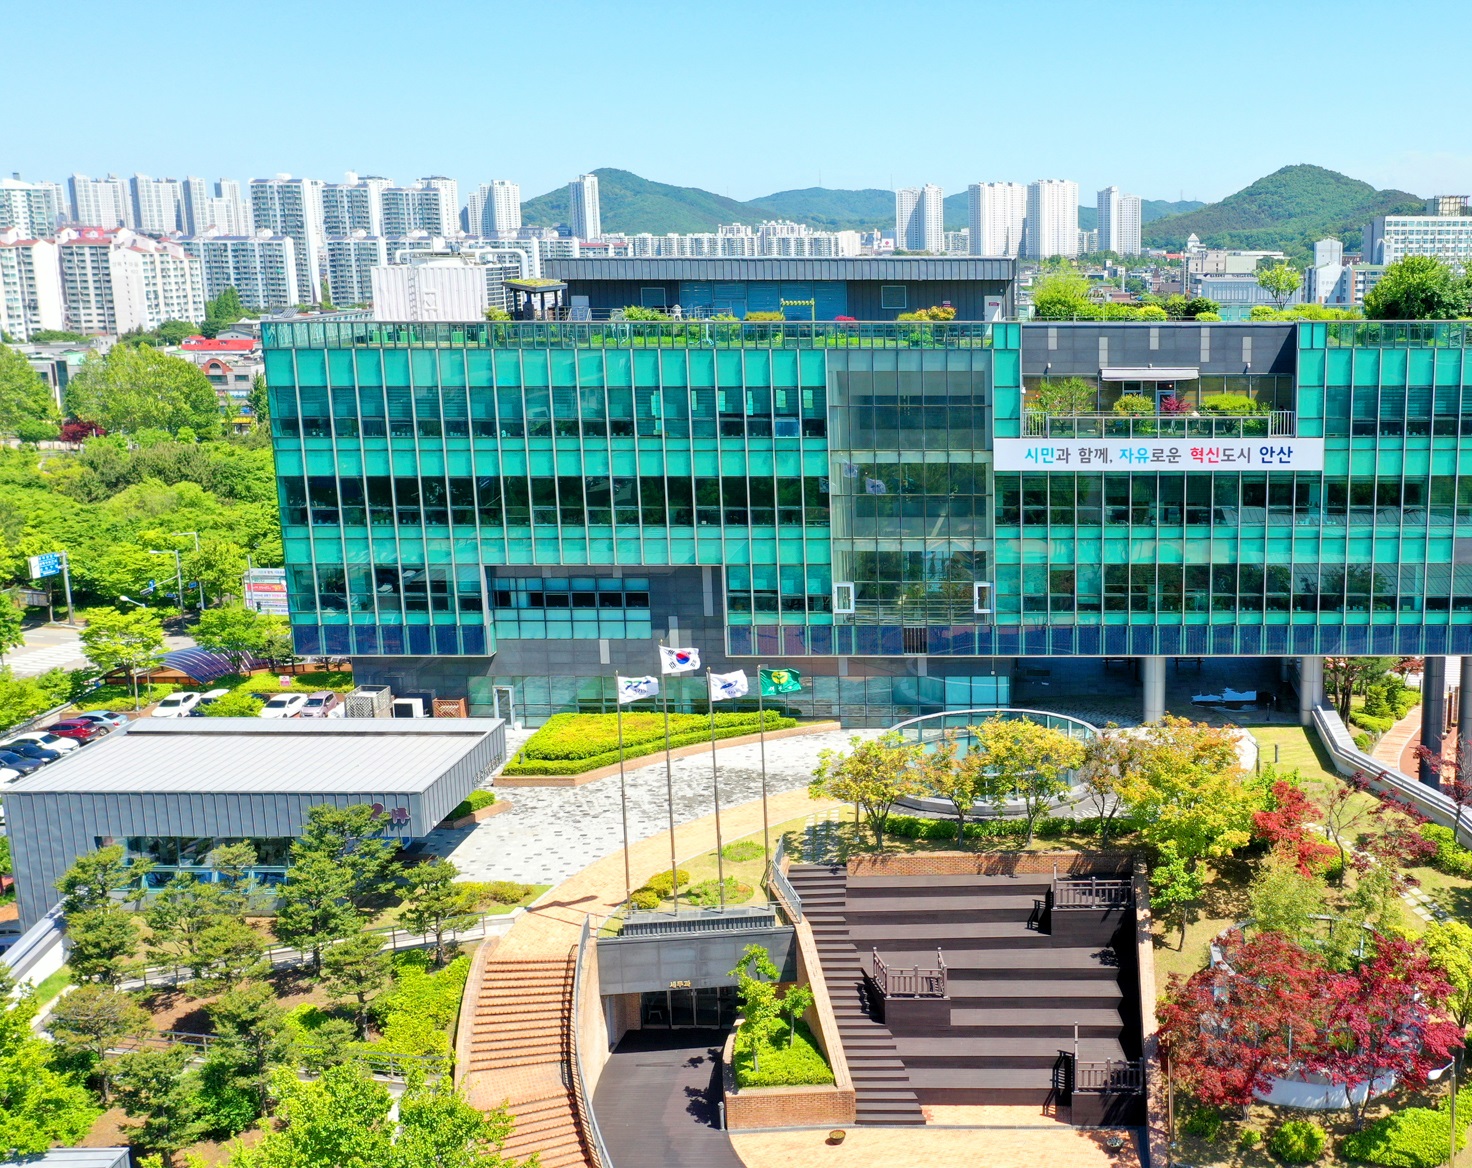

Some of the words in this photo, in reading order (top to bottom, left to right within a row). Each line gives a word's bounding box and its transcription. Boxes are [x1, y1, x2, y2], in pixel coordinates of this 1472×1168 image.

[1025, 446, 1071, 464] 시민과
[1078, 446, 1113, 464] 함께,
[1119, 446, 1182, 464] 자유로운
[1190, 446, 1251, 464] 혁신도시
[1259, 446, 1293, 464] 안산
[669, 980, 691, 989] 세무과
